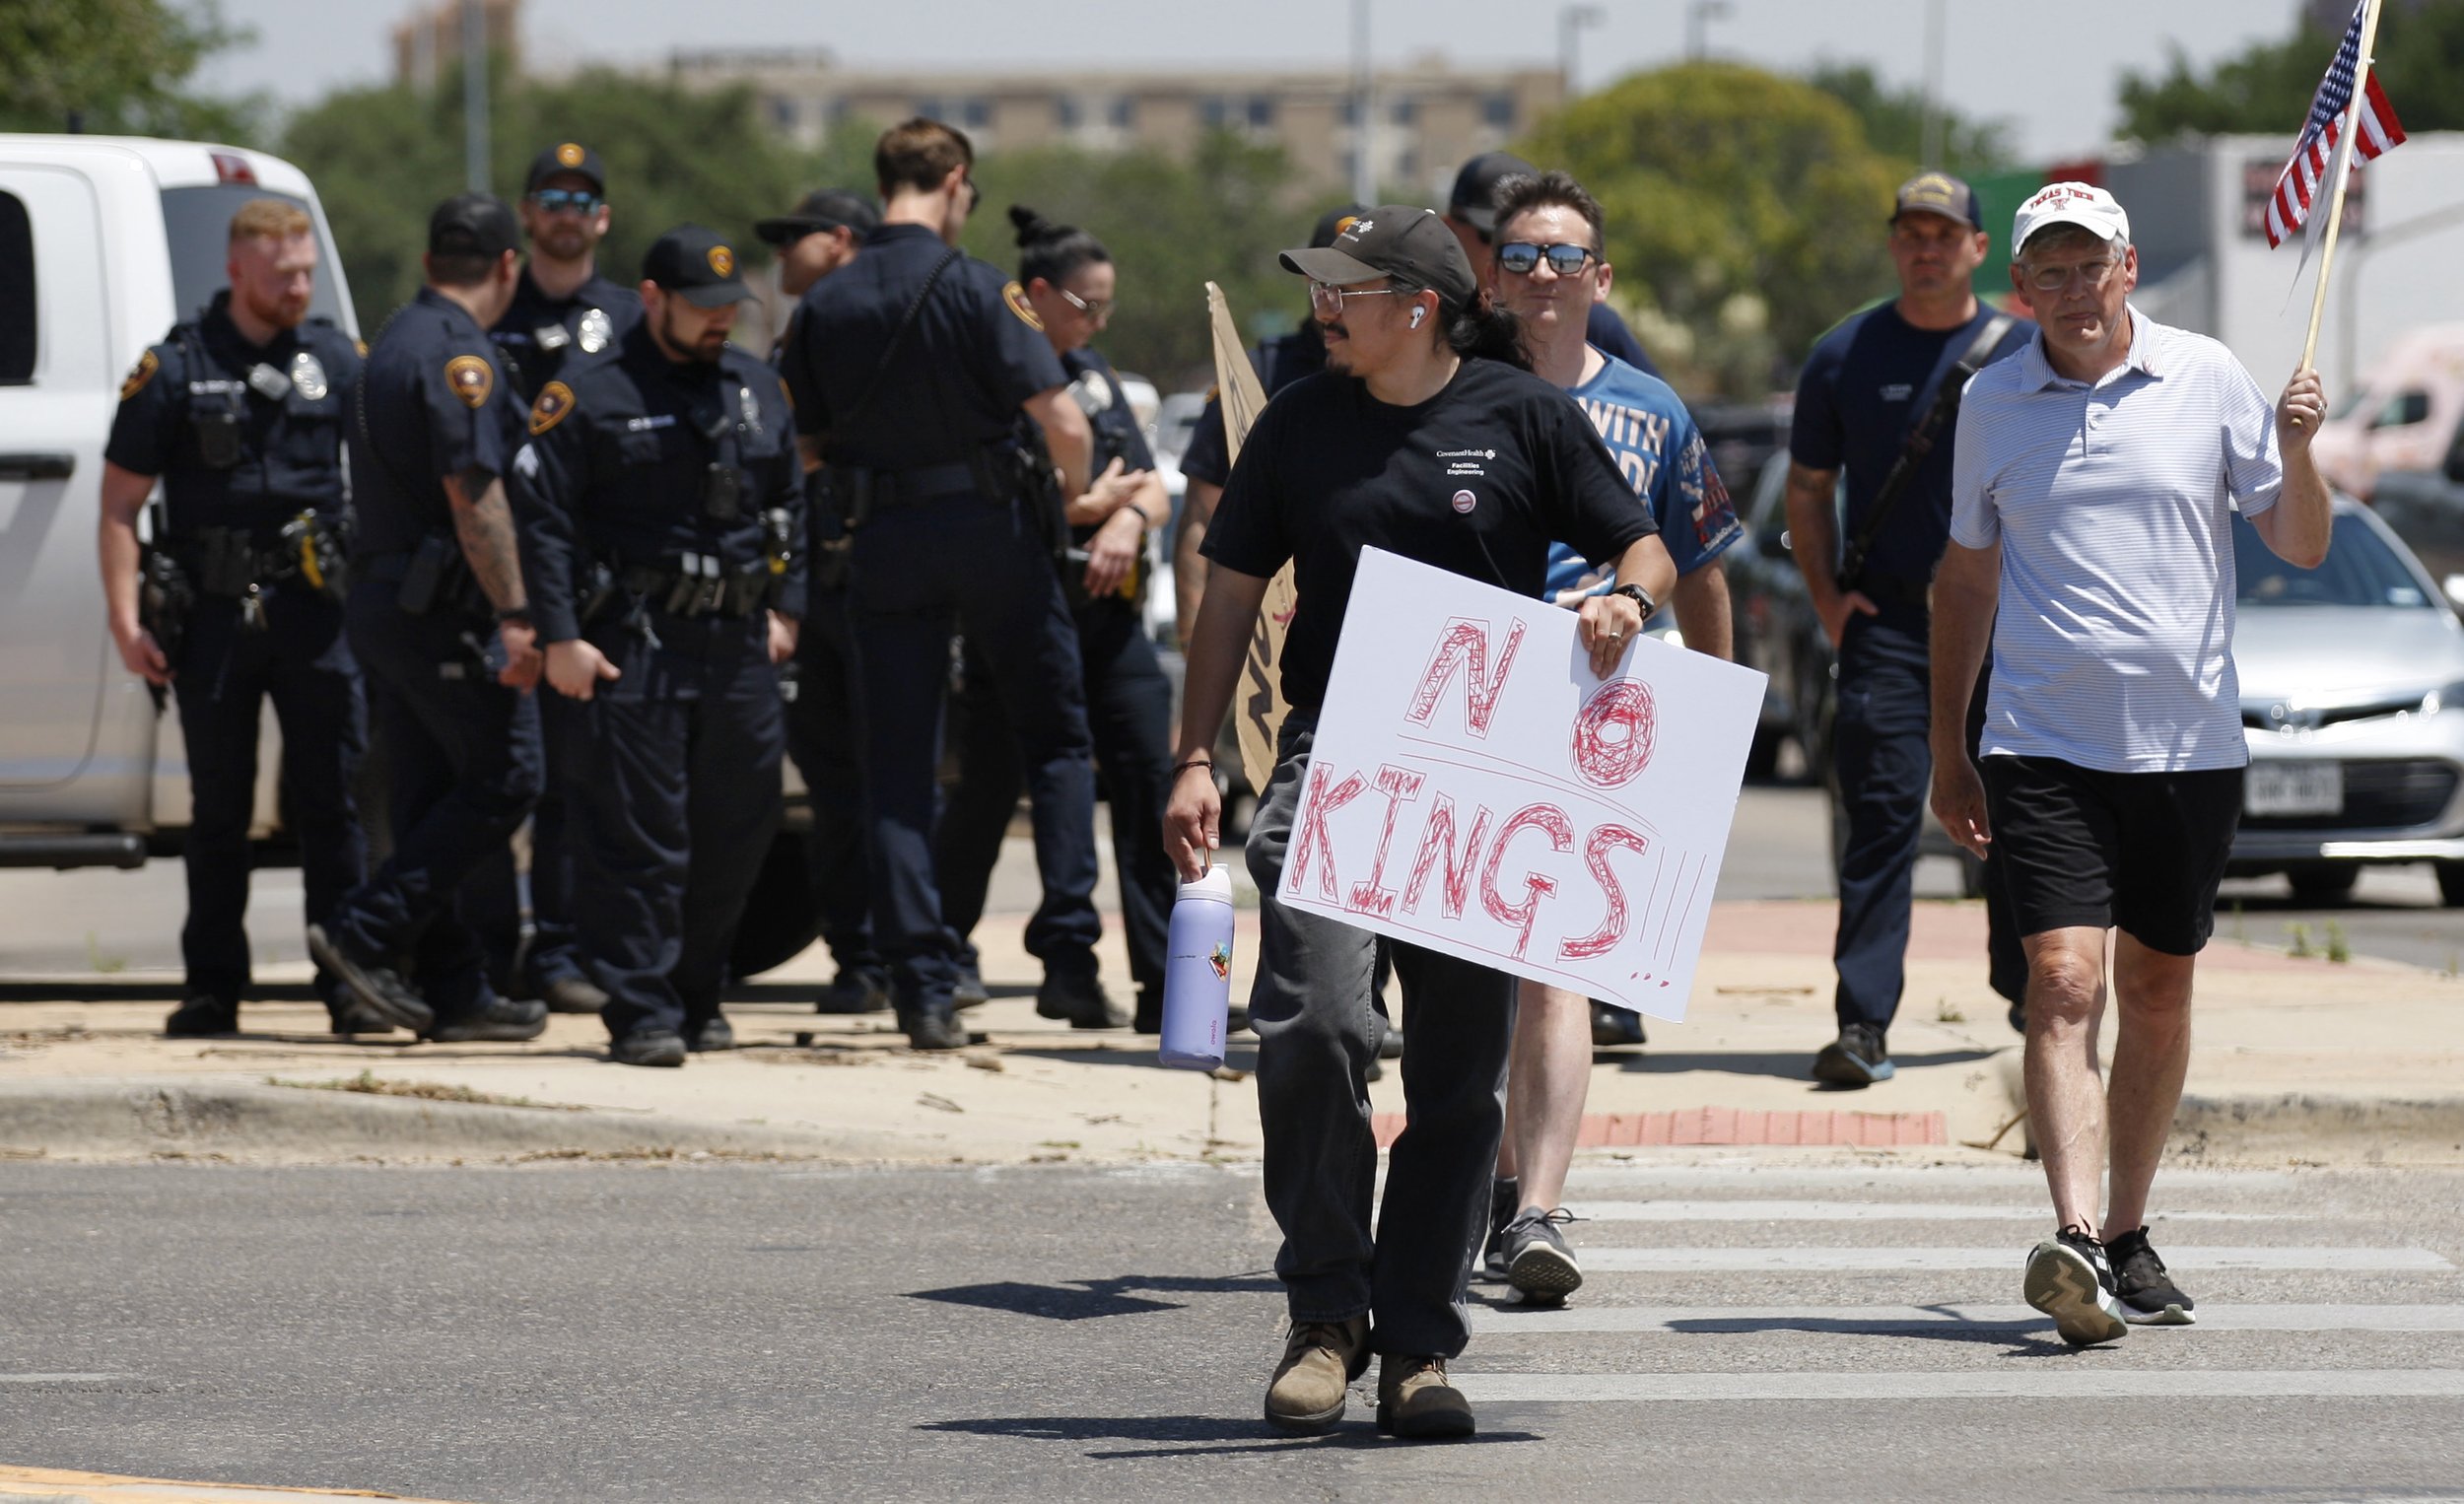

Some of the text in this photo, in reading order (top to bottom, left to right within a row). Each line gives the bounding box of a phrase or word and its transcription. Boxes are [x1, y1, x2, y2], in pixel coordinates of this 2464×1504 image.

[2029, 187, 2094, 210] TEXAS TECH
[1577, 396, 1671, 457] WITH
[1403, 615, 1659, 790] NO
